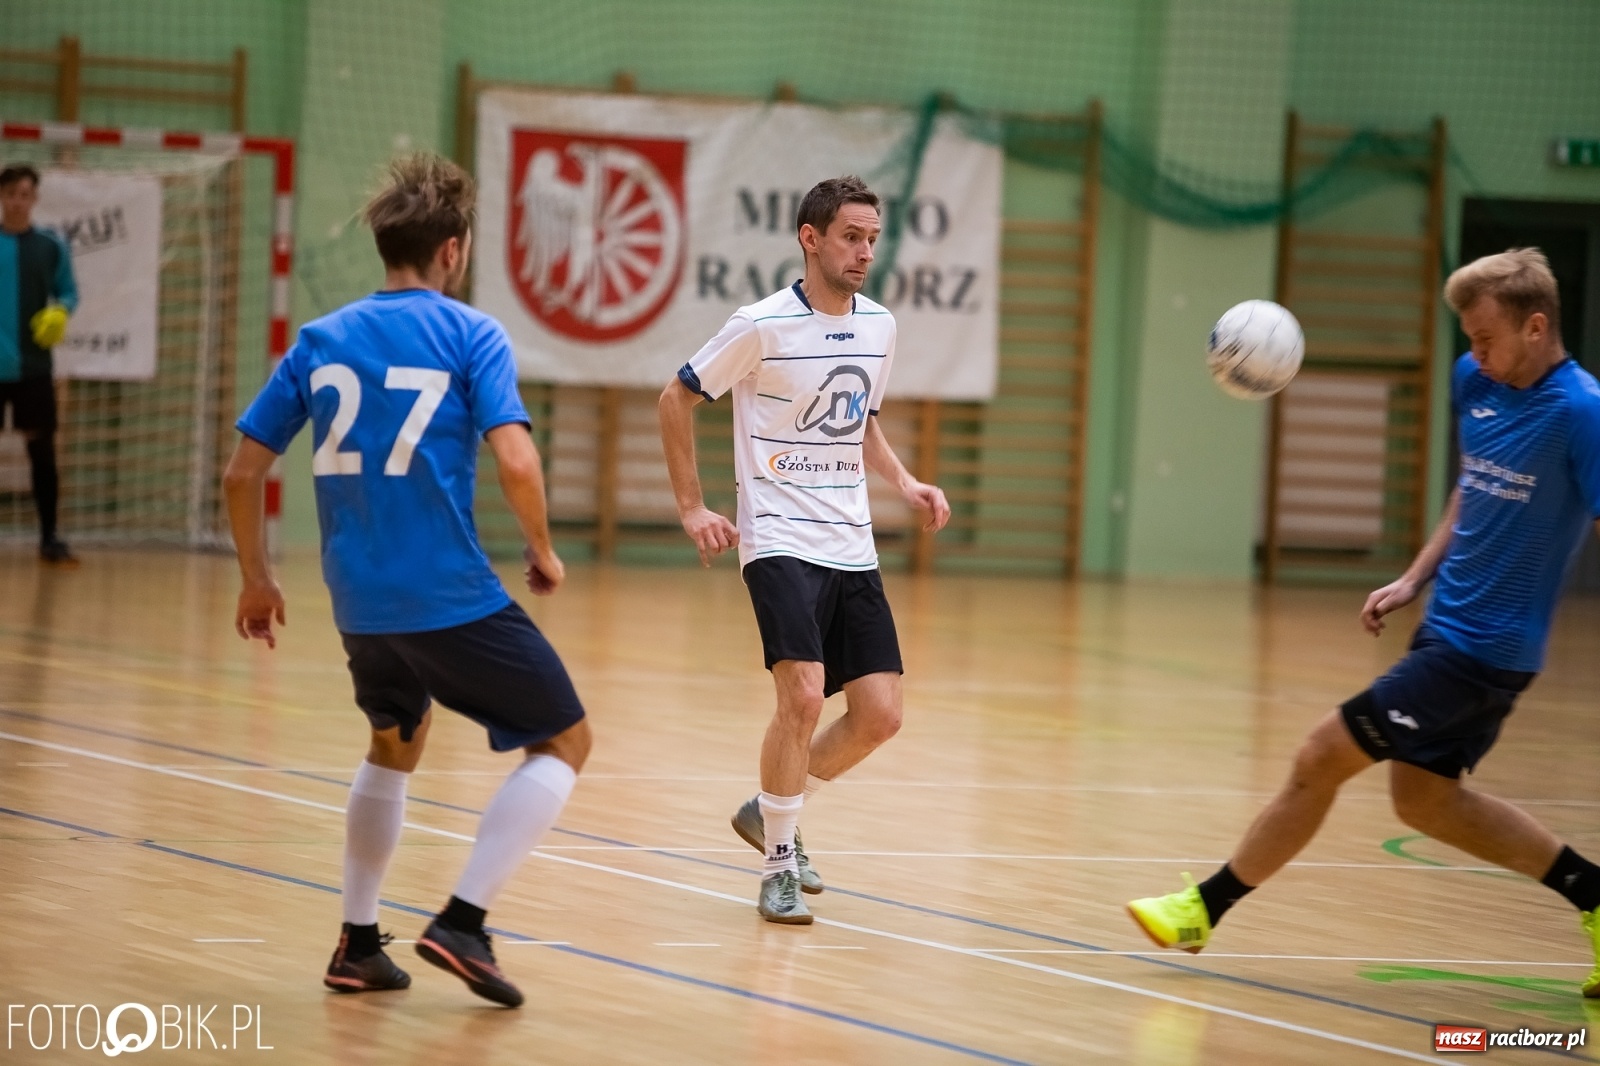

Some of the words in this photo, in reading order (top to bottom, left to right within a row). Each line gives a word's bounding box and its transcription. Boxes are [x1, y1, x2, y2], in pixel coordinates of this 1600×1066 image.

[737, 190, 950, 241] MITO
[698, 255, 979, 312] RACORZ
[825, 331, 855, 342] regio
[309, 363, 451, 476] 27
